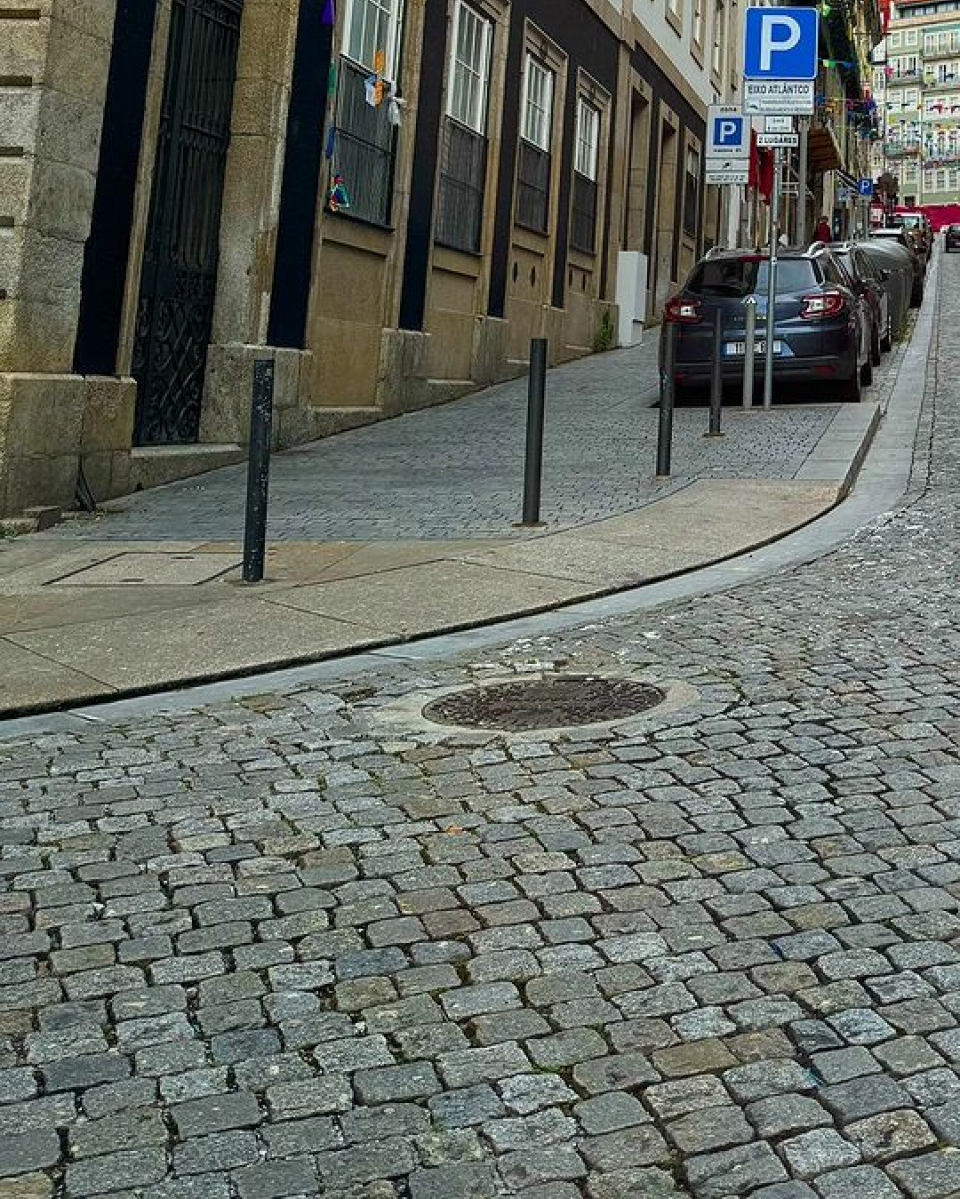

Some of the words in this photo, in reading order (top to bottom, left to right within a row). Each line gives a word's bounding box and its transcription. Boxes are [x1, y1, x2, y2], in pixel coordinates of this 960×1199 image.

[760, 14, 801, 72] P
[720, 121, 737, 144] P
[861, 181, 870, 193] P
